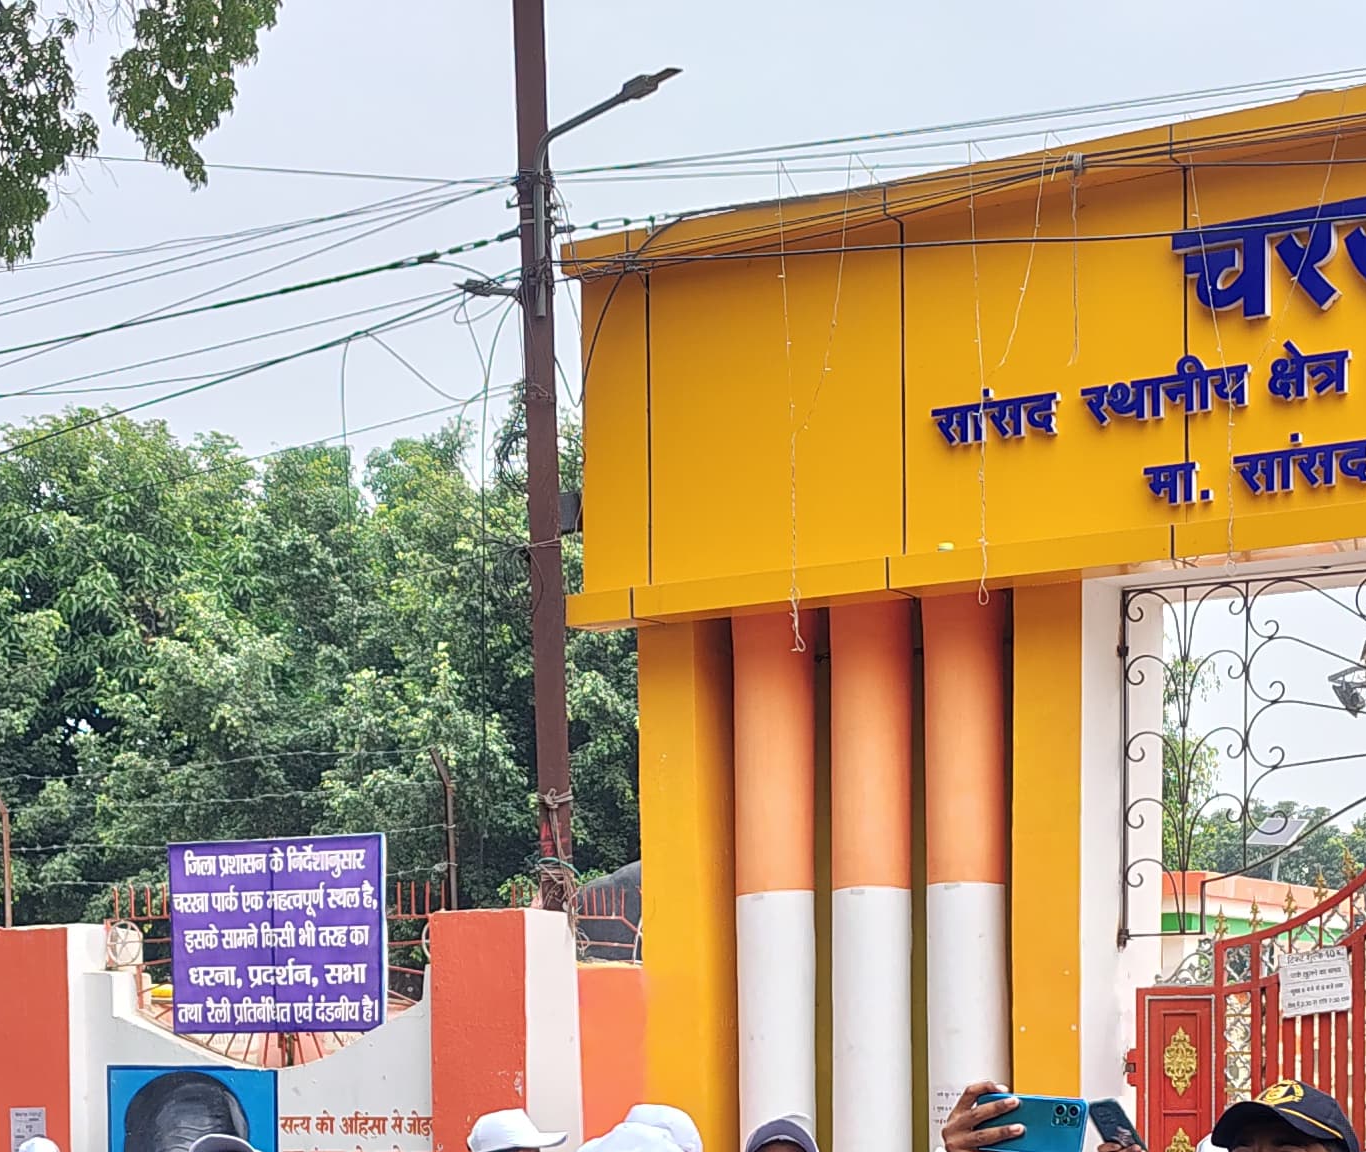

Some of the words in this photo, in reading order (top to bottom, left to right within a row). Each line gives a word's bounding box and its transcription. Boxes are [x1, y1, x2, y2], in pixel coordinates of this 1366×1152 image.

[931, 388, 1061, 446] सांसद
[1081, 355, 1252, 426] स्थानीय
[1267, 340, 1352, 399] क्षेत्र
[1144, 461, 1213, 505] मा.
[184, 851, 216, 875] जिला
[219, 853, 266, 878] प्रशासन
[270, 847, 284, 873] के
[287, 845, 365, 877] निर्देशानुसार
[173, 893, 208, 913] चरखा
[212, 885, 238, 912] पार्क
[241, 891, 264, 912] एक
[267, 881, 324, 916] महत्वपूर्ण
[327, 887, 360, 910] स्थल
[362, 881, 378, 911] है,
[184, 925, 219, 952] इसके
[221, 924, 258, 949] सामने
[261, 922, 295, 948] किसी
[299, 920, 316, 947] भी
[319, 925, 347, 947] तरह
[350, 925, 369, 946] का
[189, 965, 243, 988] धरना,
[248, 958, 318, 988] प्रदर्शन,
[325, 963, 366, 985] सभा
[178, 1003, 202, 1023] तथा
[207, 997, 231, 1023] रैली
[234, 996, 291, 1025] प्रतिबंधित
[294, 995, 312, 1023] एवं
[315, 996, 359, 1022] दंडनीय
[363, 995, 378, 1021] है।
[280, 1116, 311, 1134] सत्य
[316, 1110, 335, 1135] को
[339, 1110, 388, 1139] अहिंसा
[391, 1109, 404, 1135] से
